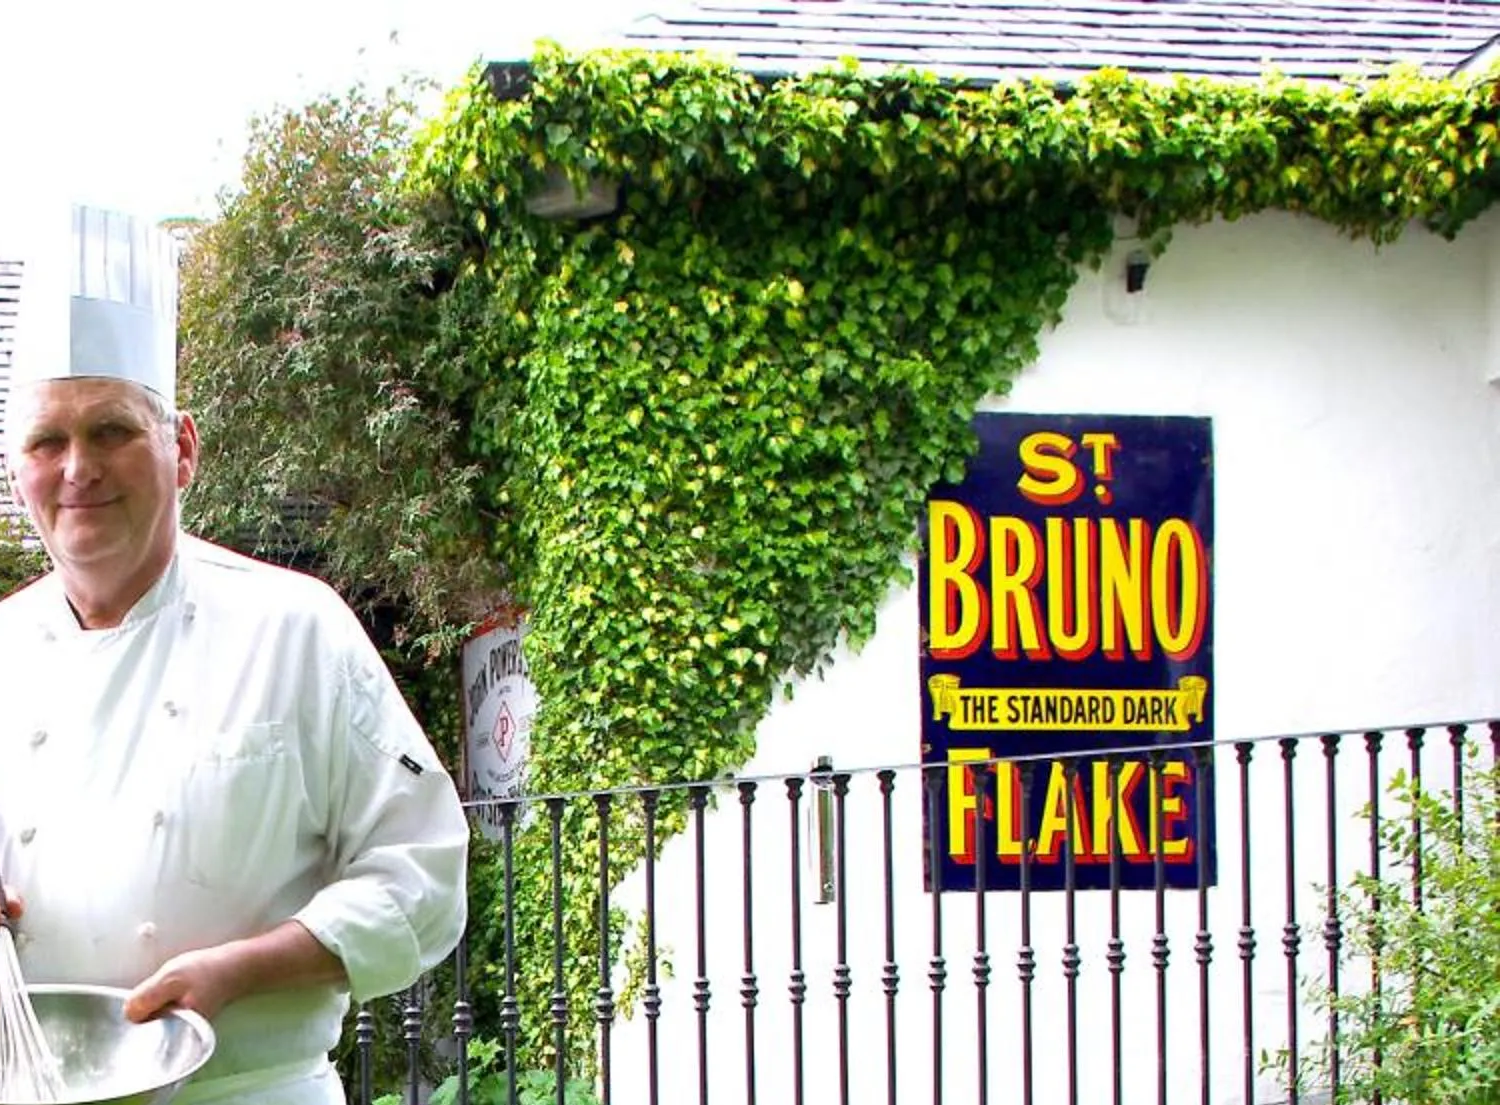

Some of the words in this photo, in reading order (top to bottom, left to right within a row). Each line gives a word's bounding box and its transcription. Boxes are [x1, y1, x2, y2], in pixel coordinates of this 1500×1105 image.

[928, 500, 1208, 661] BRUNO
[960, 695, 998, 725] THE
[1007, 695, 1115, 725] STANDARD
[1122, 695, 1178, 726] DARK
[947, 747, 1195, 864] FLAKE
